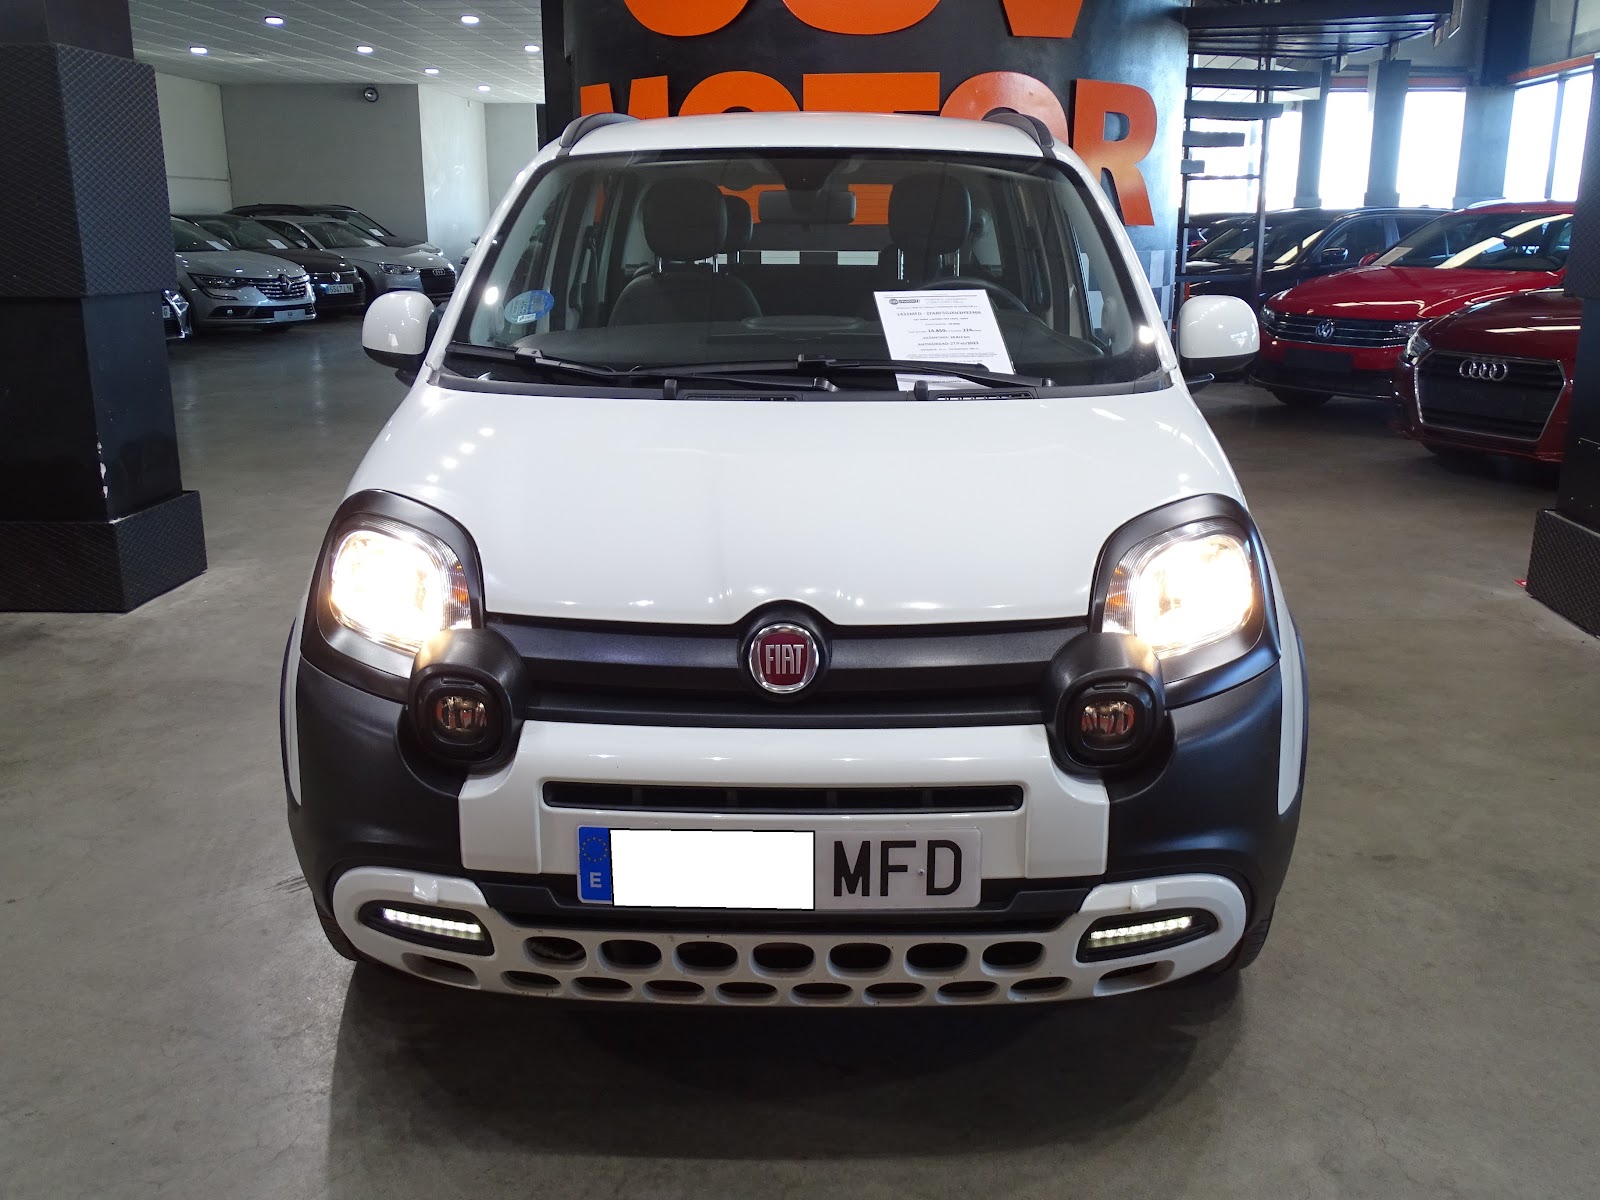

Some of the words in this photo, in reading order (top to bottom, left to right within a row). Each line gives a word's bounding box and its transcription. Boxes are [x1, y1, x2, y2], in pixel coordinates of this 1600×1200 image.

[765, 644, 804, 675] FIAT
[590, 872, 602, 888] E
[833, 839, 963, 897] MFD
